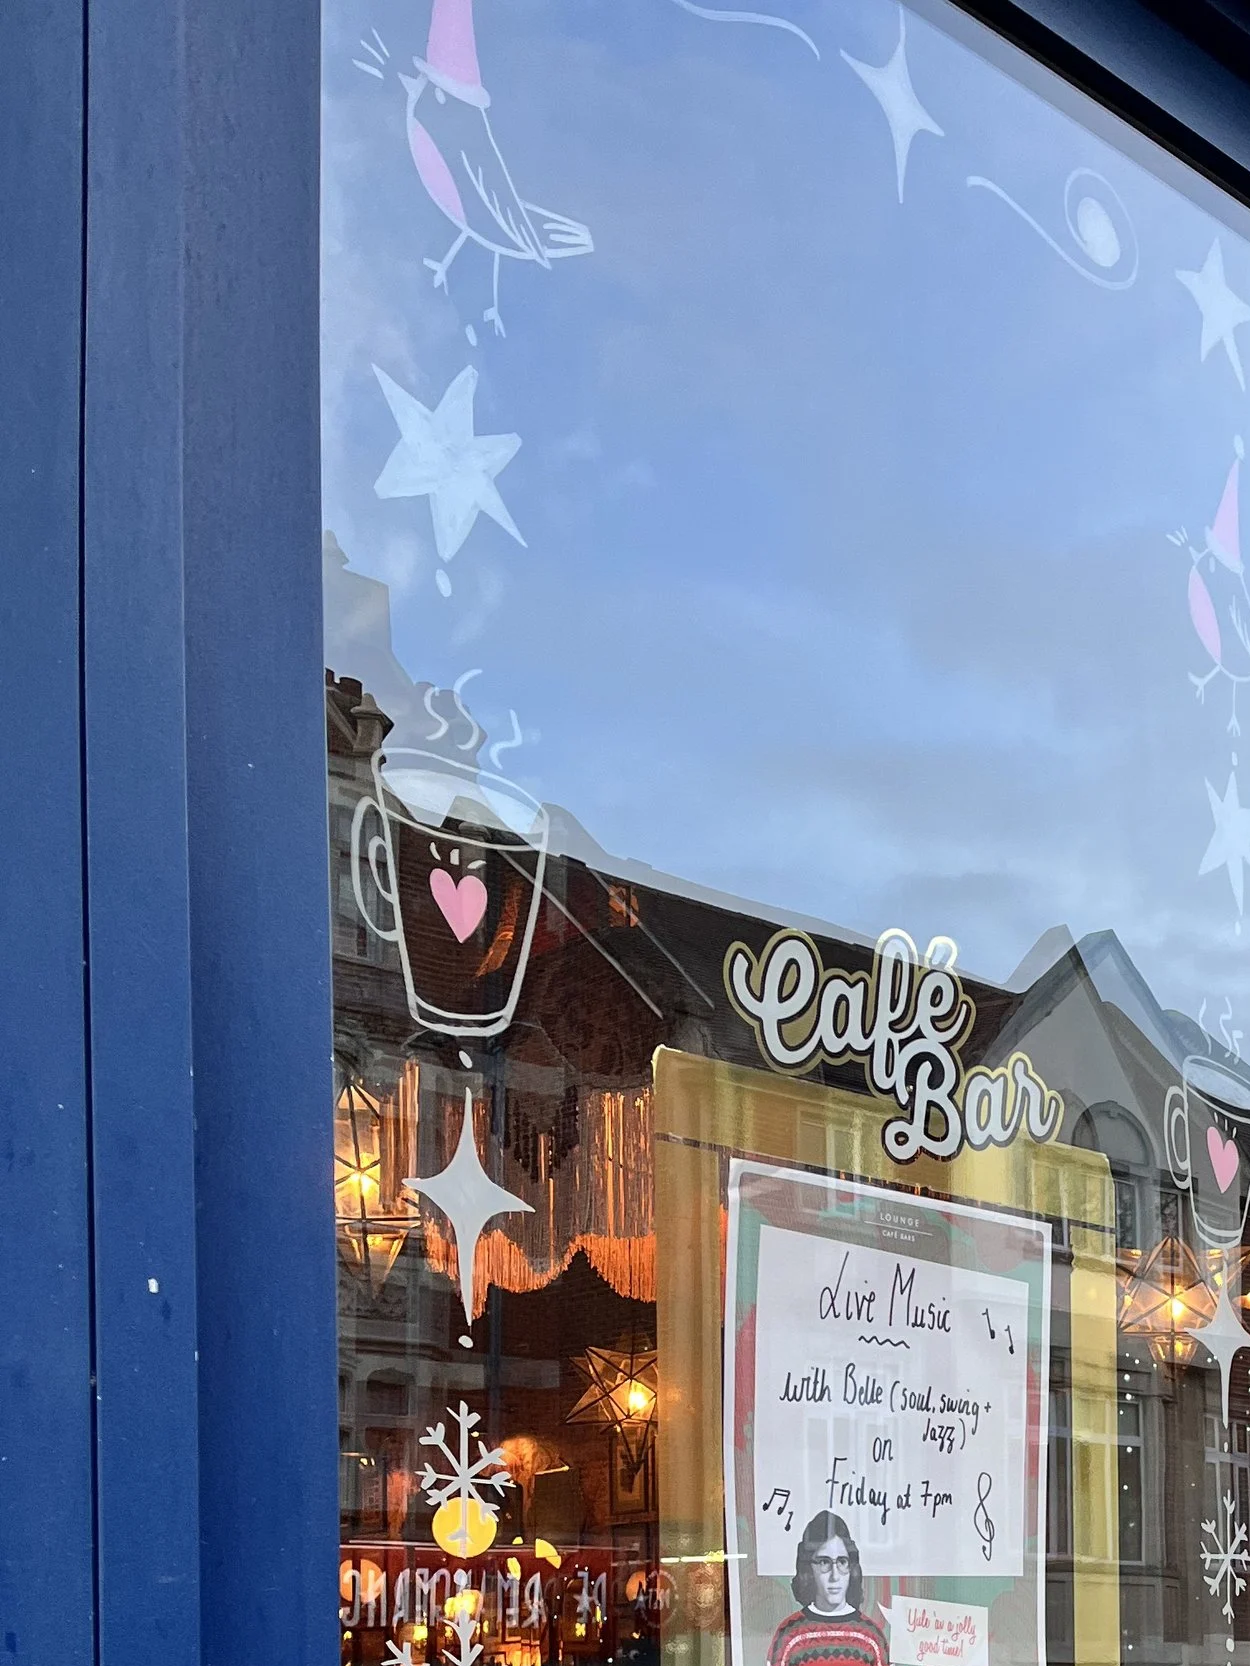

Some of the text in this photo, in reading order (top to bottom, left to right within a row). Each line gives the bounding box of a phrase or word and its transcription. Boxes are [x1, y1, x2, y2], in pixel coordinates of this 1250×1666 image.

[726, 929, 975, 1097] Café
[882, 1038, 1063, 1162] Bar
[880, 1212, 919, 1227] LOUNGE
[820, 1251, 951, 1332] Live Music
[779, 1366, 832, 1403] with
[843, 1363, 883, 1405] Belle
[940, 1390, 979, 1436] swing
[873, 1437, 894, 1462] on
[826, 1457, 953, 1526] Friday at 7pm
[917, 1635, 940, 1661] good
